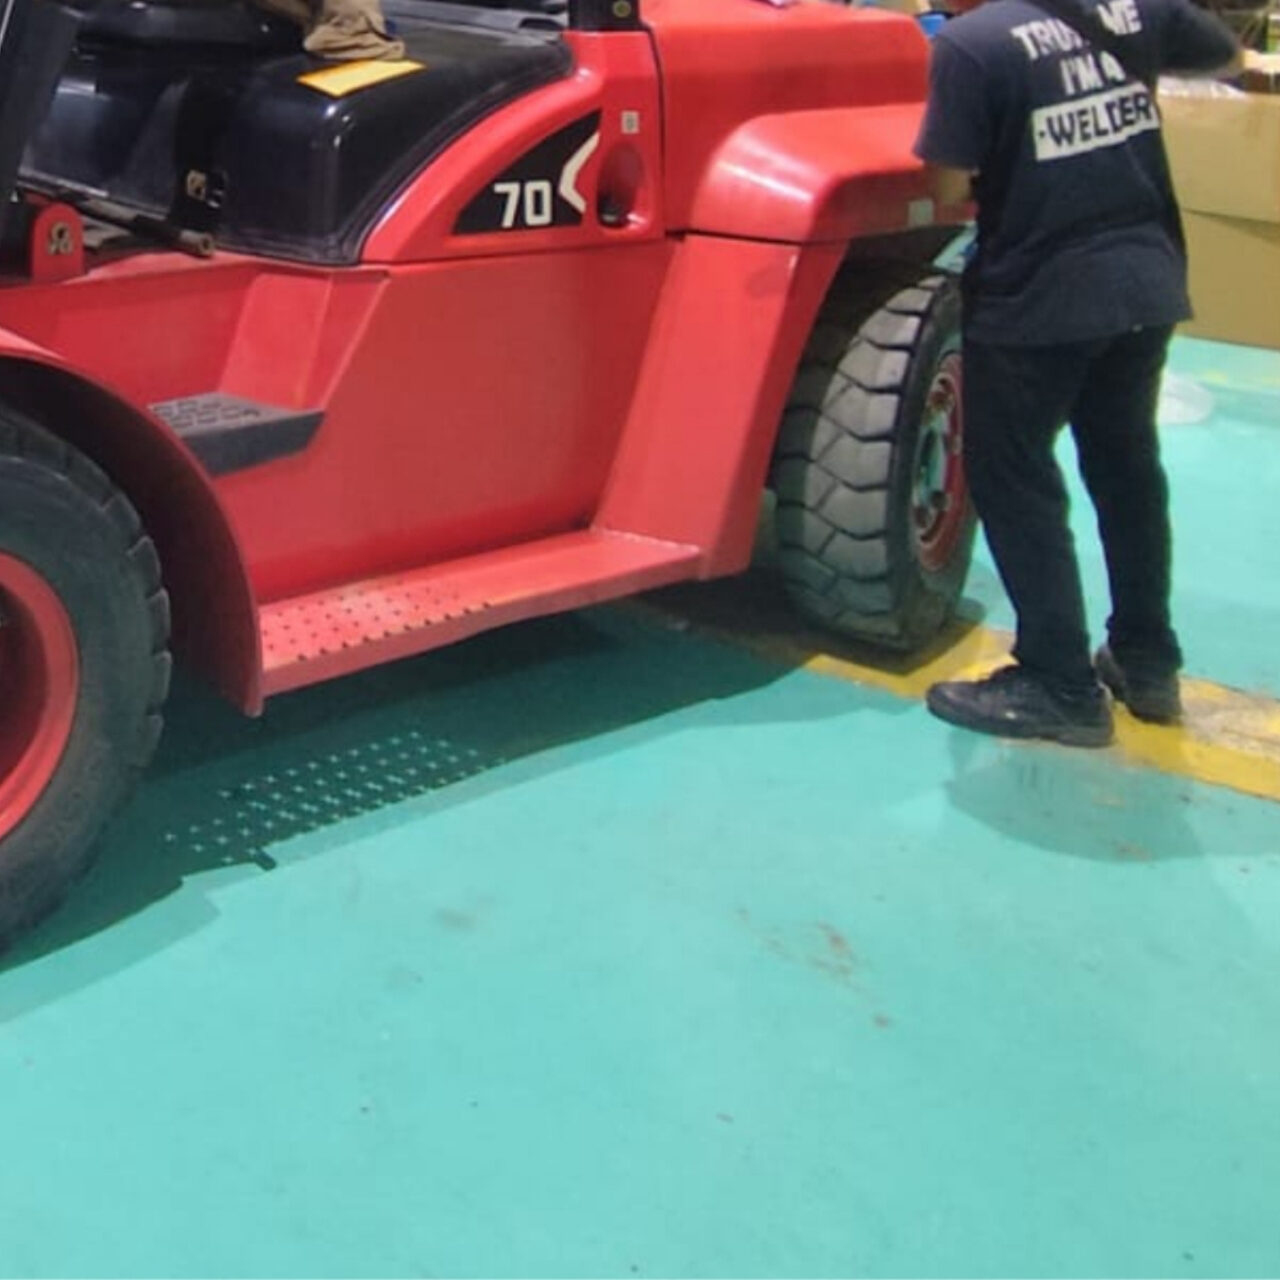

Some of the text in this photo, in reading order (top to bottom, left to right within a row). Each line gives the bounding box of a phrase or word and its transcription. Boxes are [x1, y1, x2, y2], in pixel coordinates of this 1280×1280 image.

[1100, 49, 1126, 82] A
[1044, 91, 1154, 149] WELDER
[493, 179, 553, 229] 70
